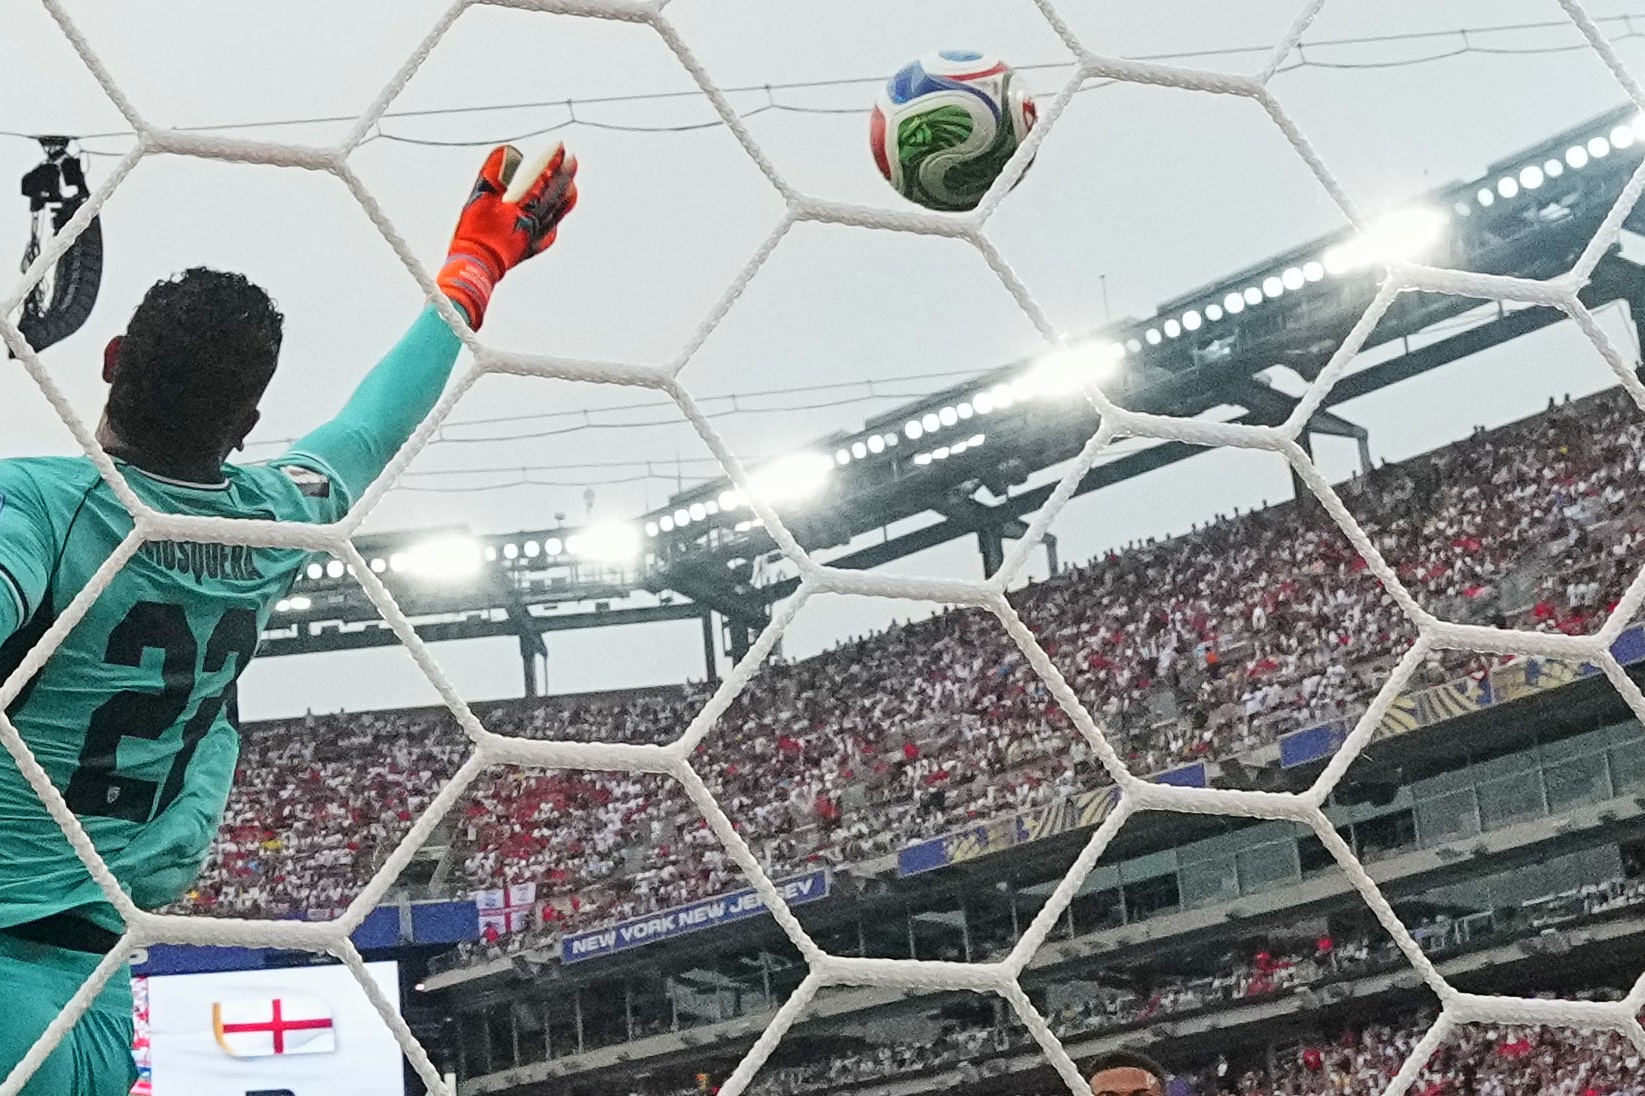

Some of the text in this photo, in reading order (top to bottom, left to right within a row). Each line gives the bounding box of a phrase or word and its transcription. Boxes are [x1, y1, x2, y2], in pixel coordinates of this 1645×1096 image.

[65, 600, 258, 823] 22
[572, 930, 617, 954] NEW
[620, 914, 676, 942] YORK
[678, 902, 726, 927] NEW
